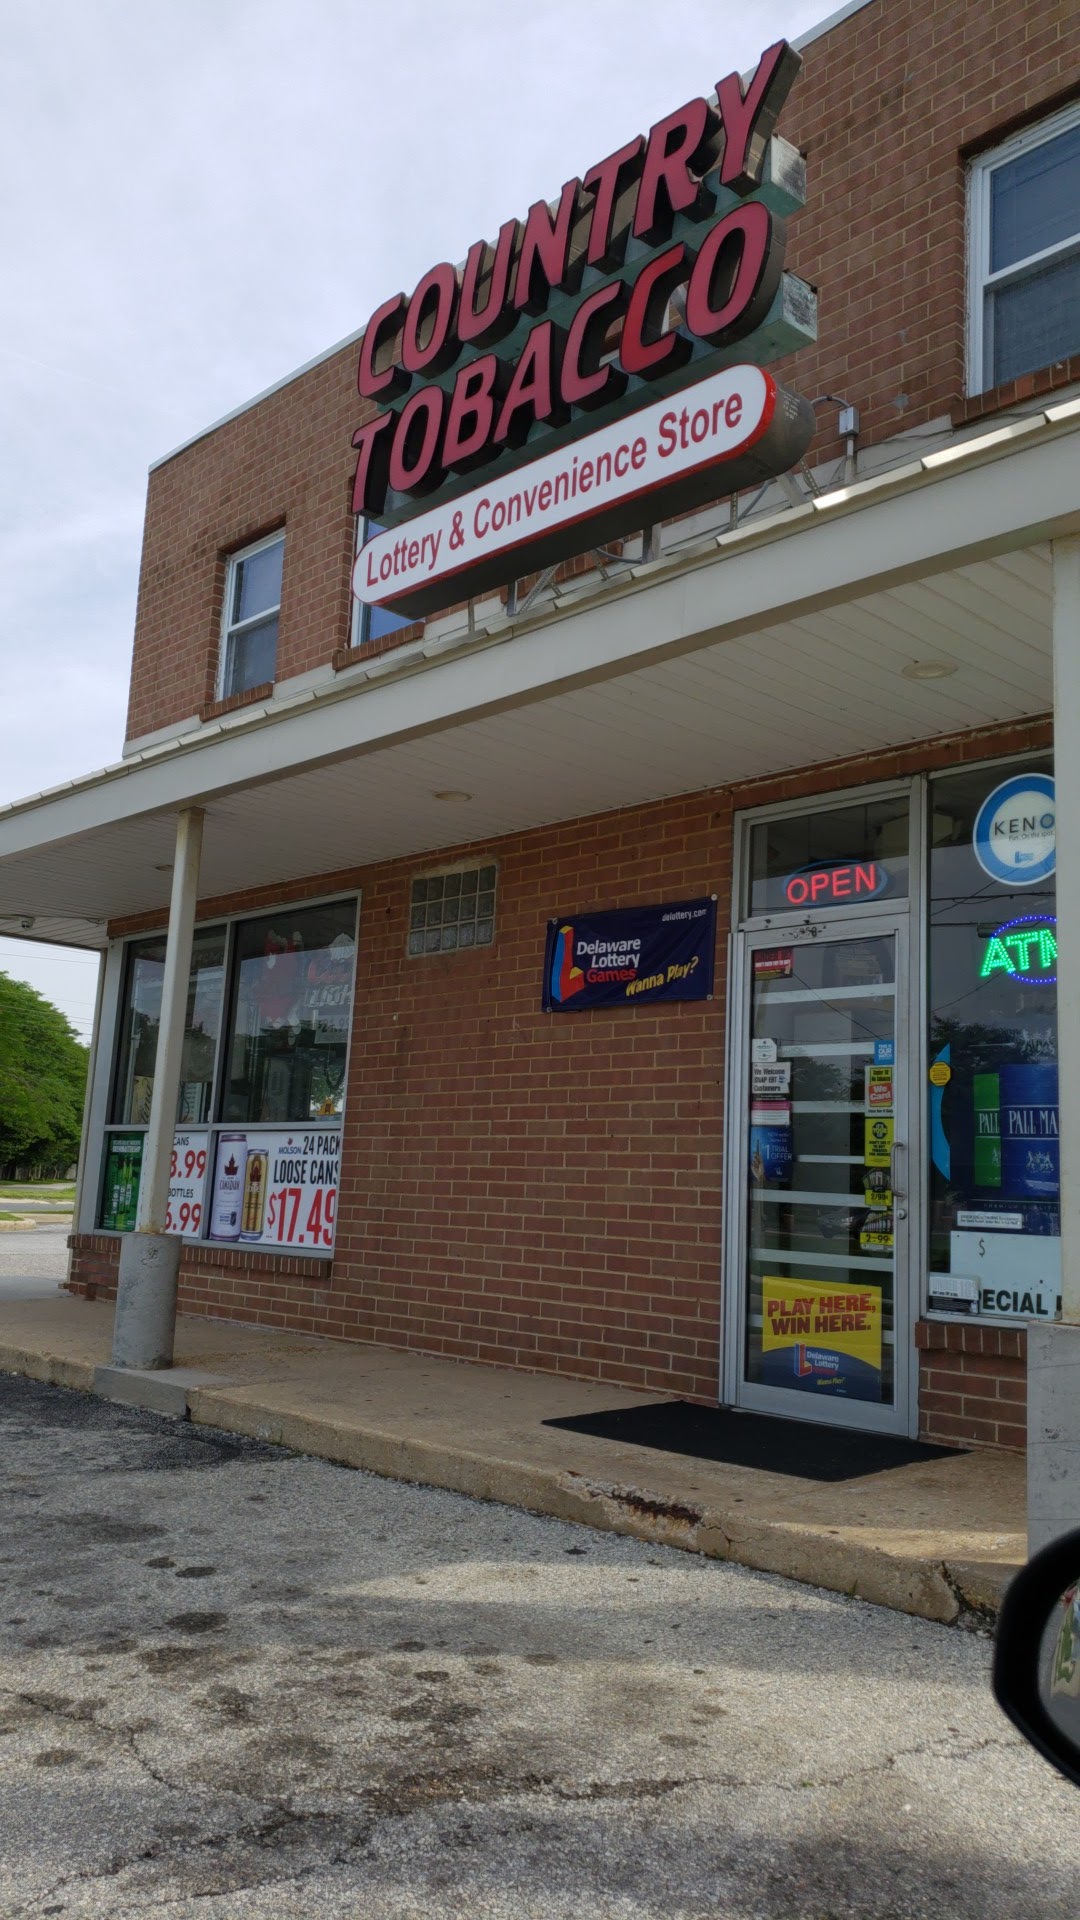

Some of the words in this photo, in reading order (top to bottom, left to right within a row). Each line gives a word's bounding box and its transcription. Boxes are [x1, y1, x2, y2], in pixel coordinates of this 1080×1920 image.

[358, 38, 790, 400] COUNTRY
[351, 201, 772, 515] TOBACCO
[366, 529, 442, 588] Lottery
[449, 510, 465, 550] &
[473, 436, 647, 539] Convenience
[657, 392, 743, 458] Store
[994, 813, 1055, 836] KENO
[786, 863, 876, 904] OPEN
[661, 908, 707, 922] delottery.com
[576, 938, 641, 956] Delaware
[591, 953, 641, 968] Lottery
[586, 968, 638, 984] Games
[625, 973, 665, 996] Wanna
[666, 956, 699, 982] Play?
[870, 1092, 891, 1100] Card
[873, 1085, 888, 1093] We
[979, 1112, 1000, 1134] PALL
[1008, 1110, 1037, 1134] PALL
[1040, 1110, 1060, 1134] MA
[278, 1146, 302, 1154] MOLSON
[303, 1135, 315, 1155] 24
[273, 1159, 307, 1184] LOOSE
[310, 1160, 338, 1185] CANS
[267, 1187, 336, 1246] $17.49
[978, 1238, 986, 1258] $
[767, 1298, 815, 1317] PLAY
[819, 1293, 876, 1314] HERE,
[979, 1288, 1048, 1315] ECIAL
[771, 1316, 811, 1336] WIN
[815, 1313, 872, 1334] HERE.
[806, 1351, 840, 1362] Delaware
[814, 1360, 840, 1371] Lottery
